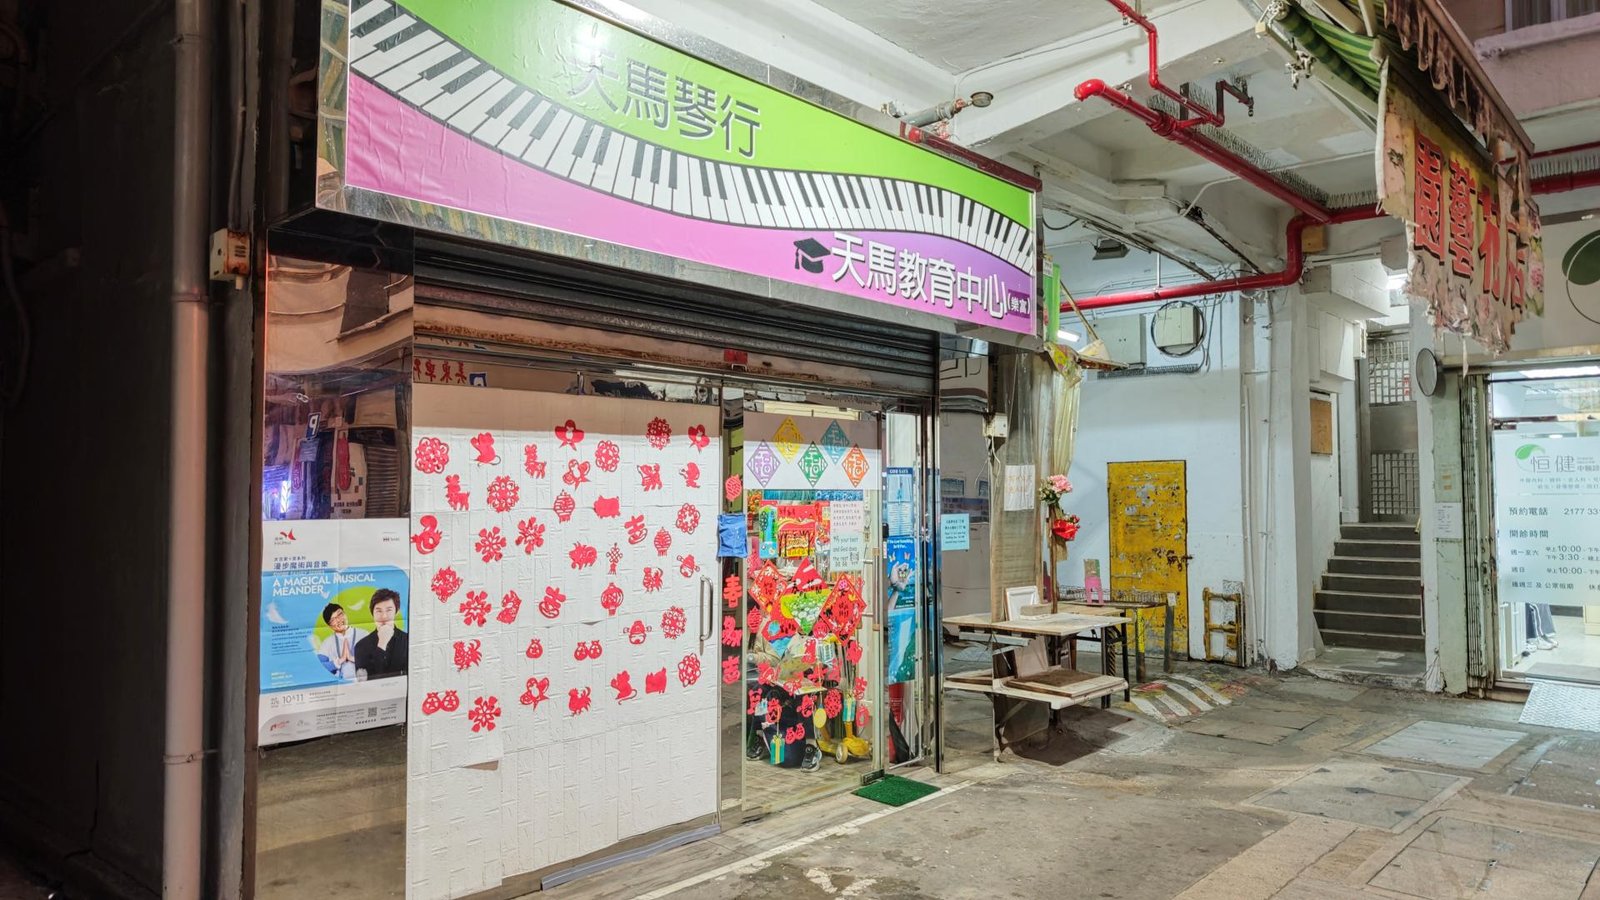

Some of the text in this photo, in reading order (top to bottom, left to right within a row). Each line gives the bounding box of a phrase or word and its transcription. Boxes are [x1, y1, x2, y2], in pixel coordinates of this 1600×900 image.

[566, 45, 763, 159] 天馬琴行
[831, 231, 1008, 320] 天馬教育中心
[1531, 455, 1576, 473] 恒健
[1509, 507, 1548, 516] 預約電話
[1509, 529, 1549, 539] 開診時間
[273, 573, 376, 587] A MAGICAL MUSICAL
[273, 585, 324, 597] MEANDER
[282, 695, 292, 704] 10
